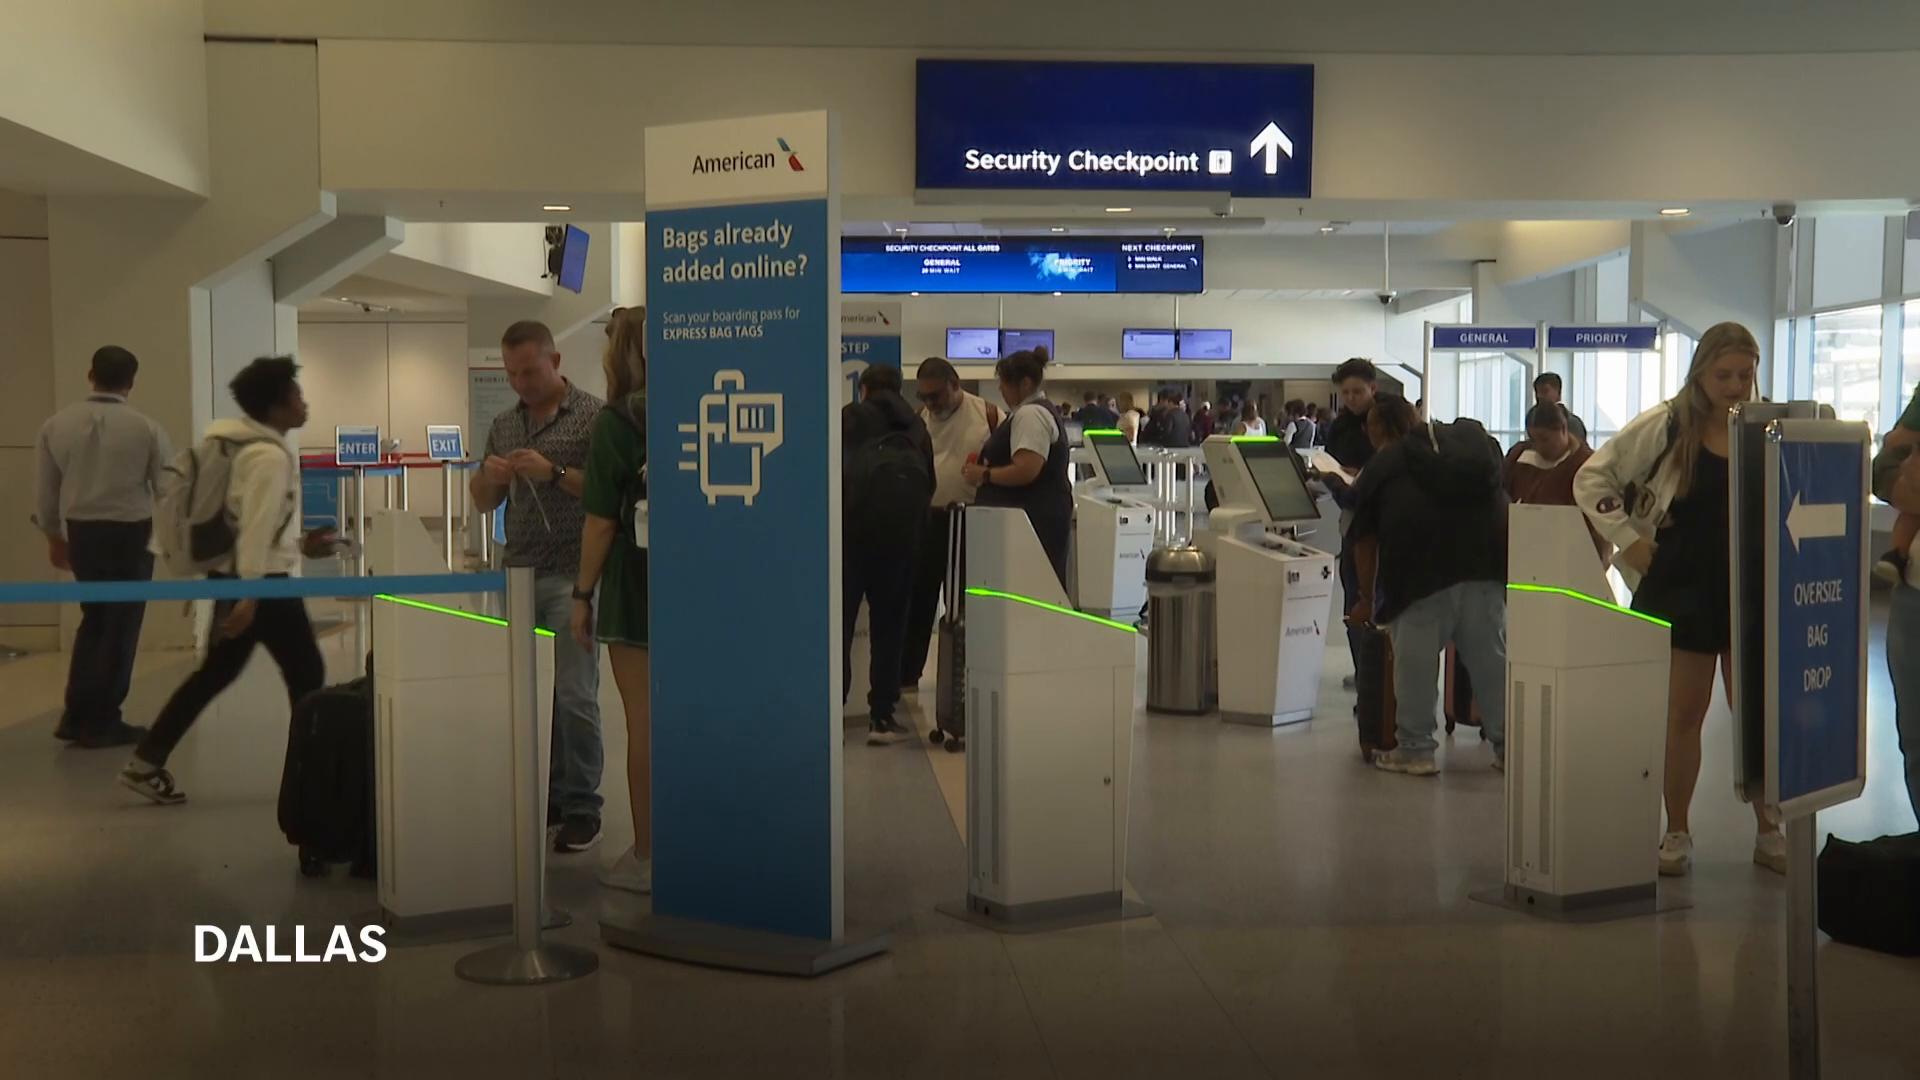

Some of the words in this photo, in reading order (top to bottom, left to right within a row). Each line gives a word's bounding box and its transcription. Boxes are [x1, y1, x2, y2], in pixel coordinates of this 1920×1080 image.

[692, 151, 775, 175] American
[964, 149, 1061, 176] Security
[1067, 149, 1200, 177] Checkpoint
[662, 227, 708, 253] Bags
[713, 219, 793, 249] already
[1121, 244, 1143, 252] NEXT
[1144, 244, 1196, 252] CHECKPOINT
[662, 258, 725, 284] added
[730, 254, 808, 280] online?
[923, 258, 961, 266] GENERAL
[1054, 258, 1091, 266] PRIORITY
[663, 311, 686, 324] Scan
[687, 311, 711, 326] your
[712, 308, 758, 324] boarding
[760, 308, 783, 324] pass
[784, 306, 800, 320] for
[841, 313, 877, 323] merican
[663, 327, 708, 340] EXPRESS
[709, 326, 732, 339] BAG
[734, 325, 763, 338] TAGS
[1460, 332, 1509, 344] GENERAL
[1576, 332, 1628, 344] PRIORITY
[841, 342, 870, 353] STEP
[340, 443, 376, 455] ENTER
[432, 438, 457, 451] EXIT
[1794, 579, 1843, 606] OVERSIZE
[1807, 624, 1828, 648] BAG
[1803, 666, 1832, 691] DROP
